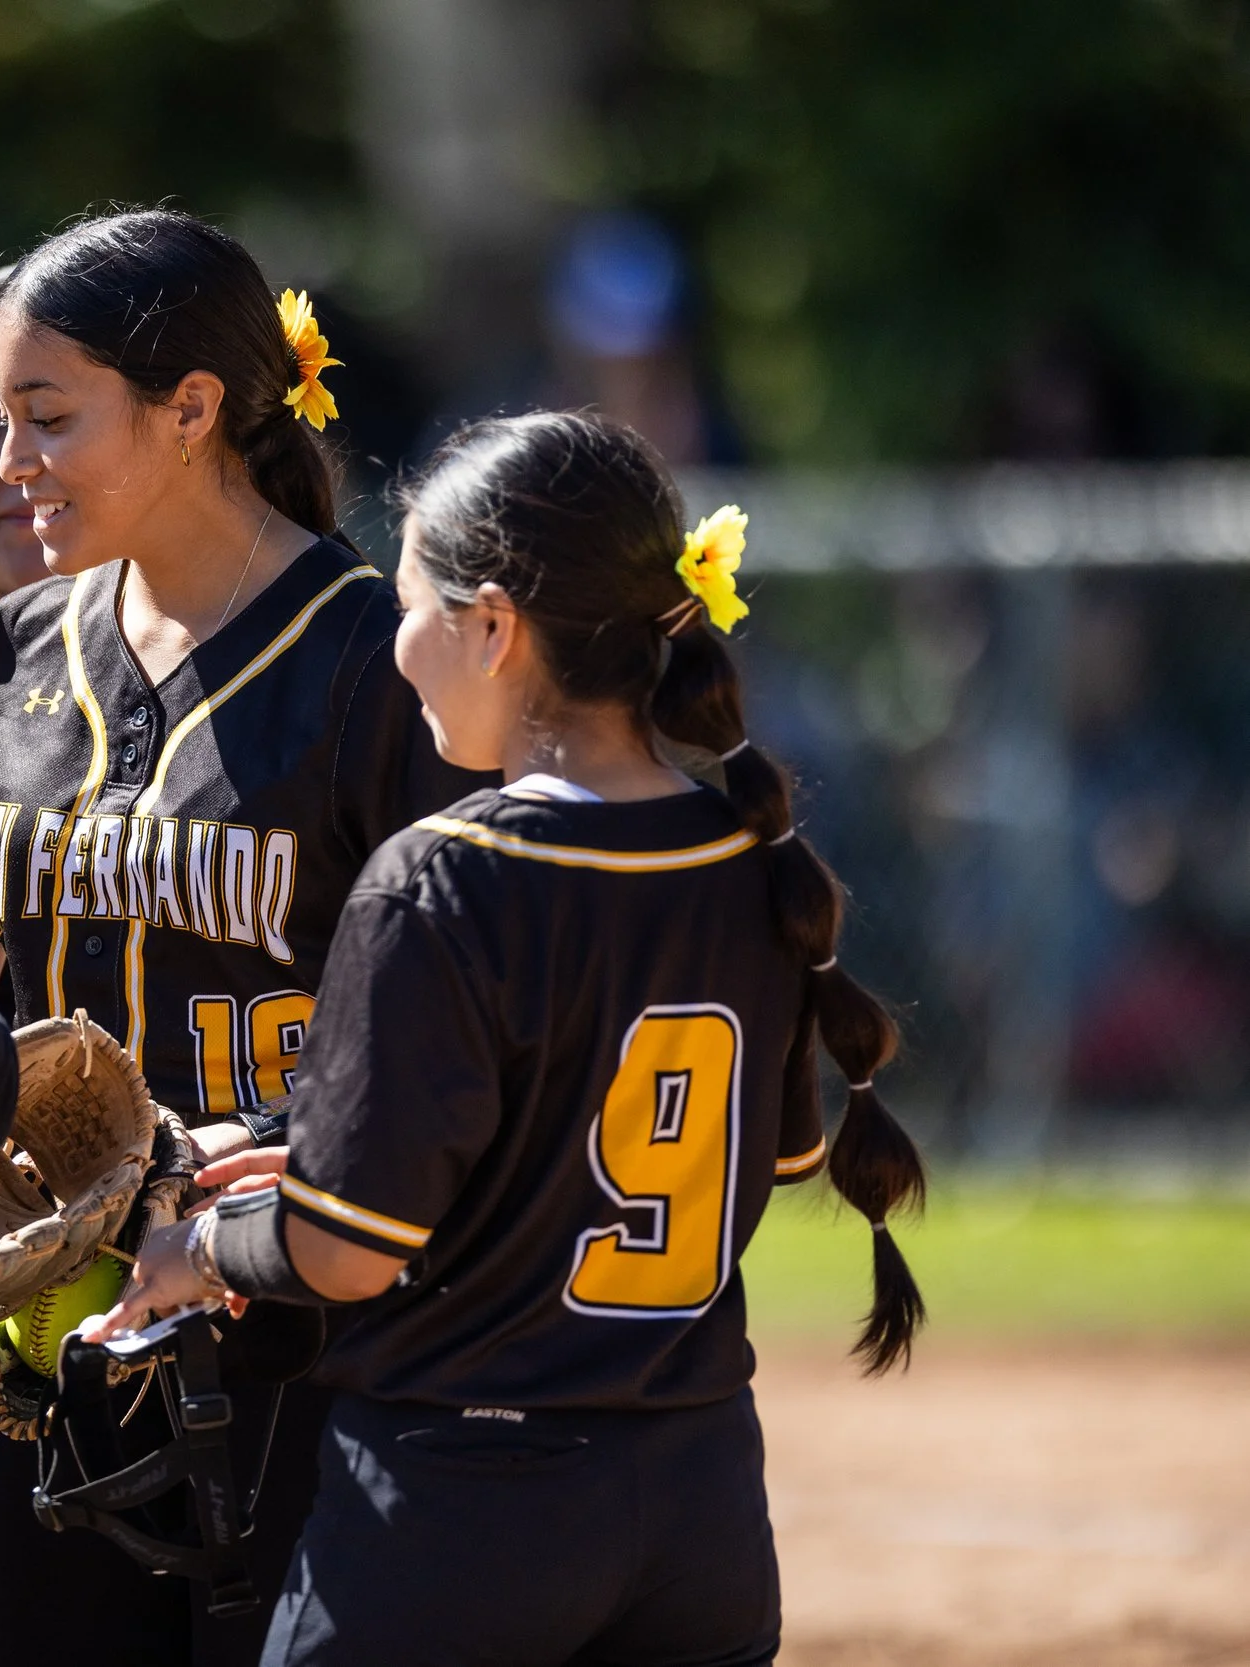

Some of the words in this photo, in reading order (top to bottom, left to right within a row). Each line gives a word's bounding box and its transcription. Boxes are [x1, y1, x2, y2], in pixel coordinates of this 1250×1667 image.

[21, 806, 298, 965] FERNANDO
[188, 989, 317, 1114] 18
[561, 1002, 744, 1319] 9
[462, 1407, 526, 1423] EASTON
